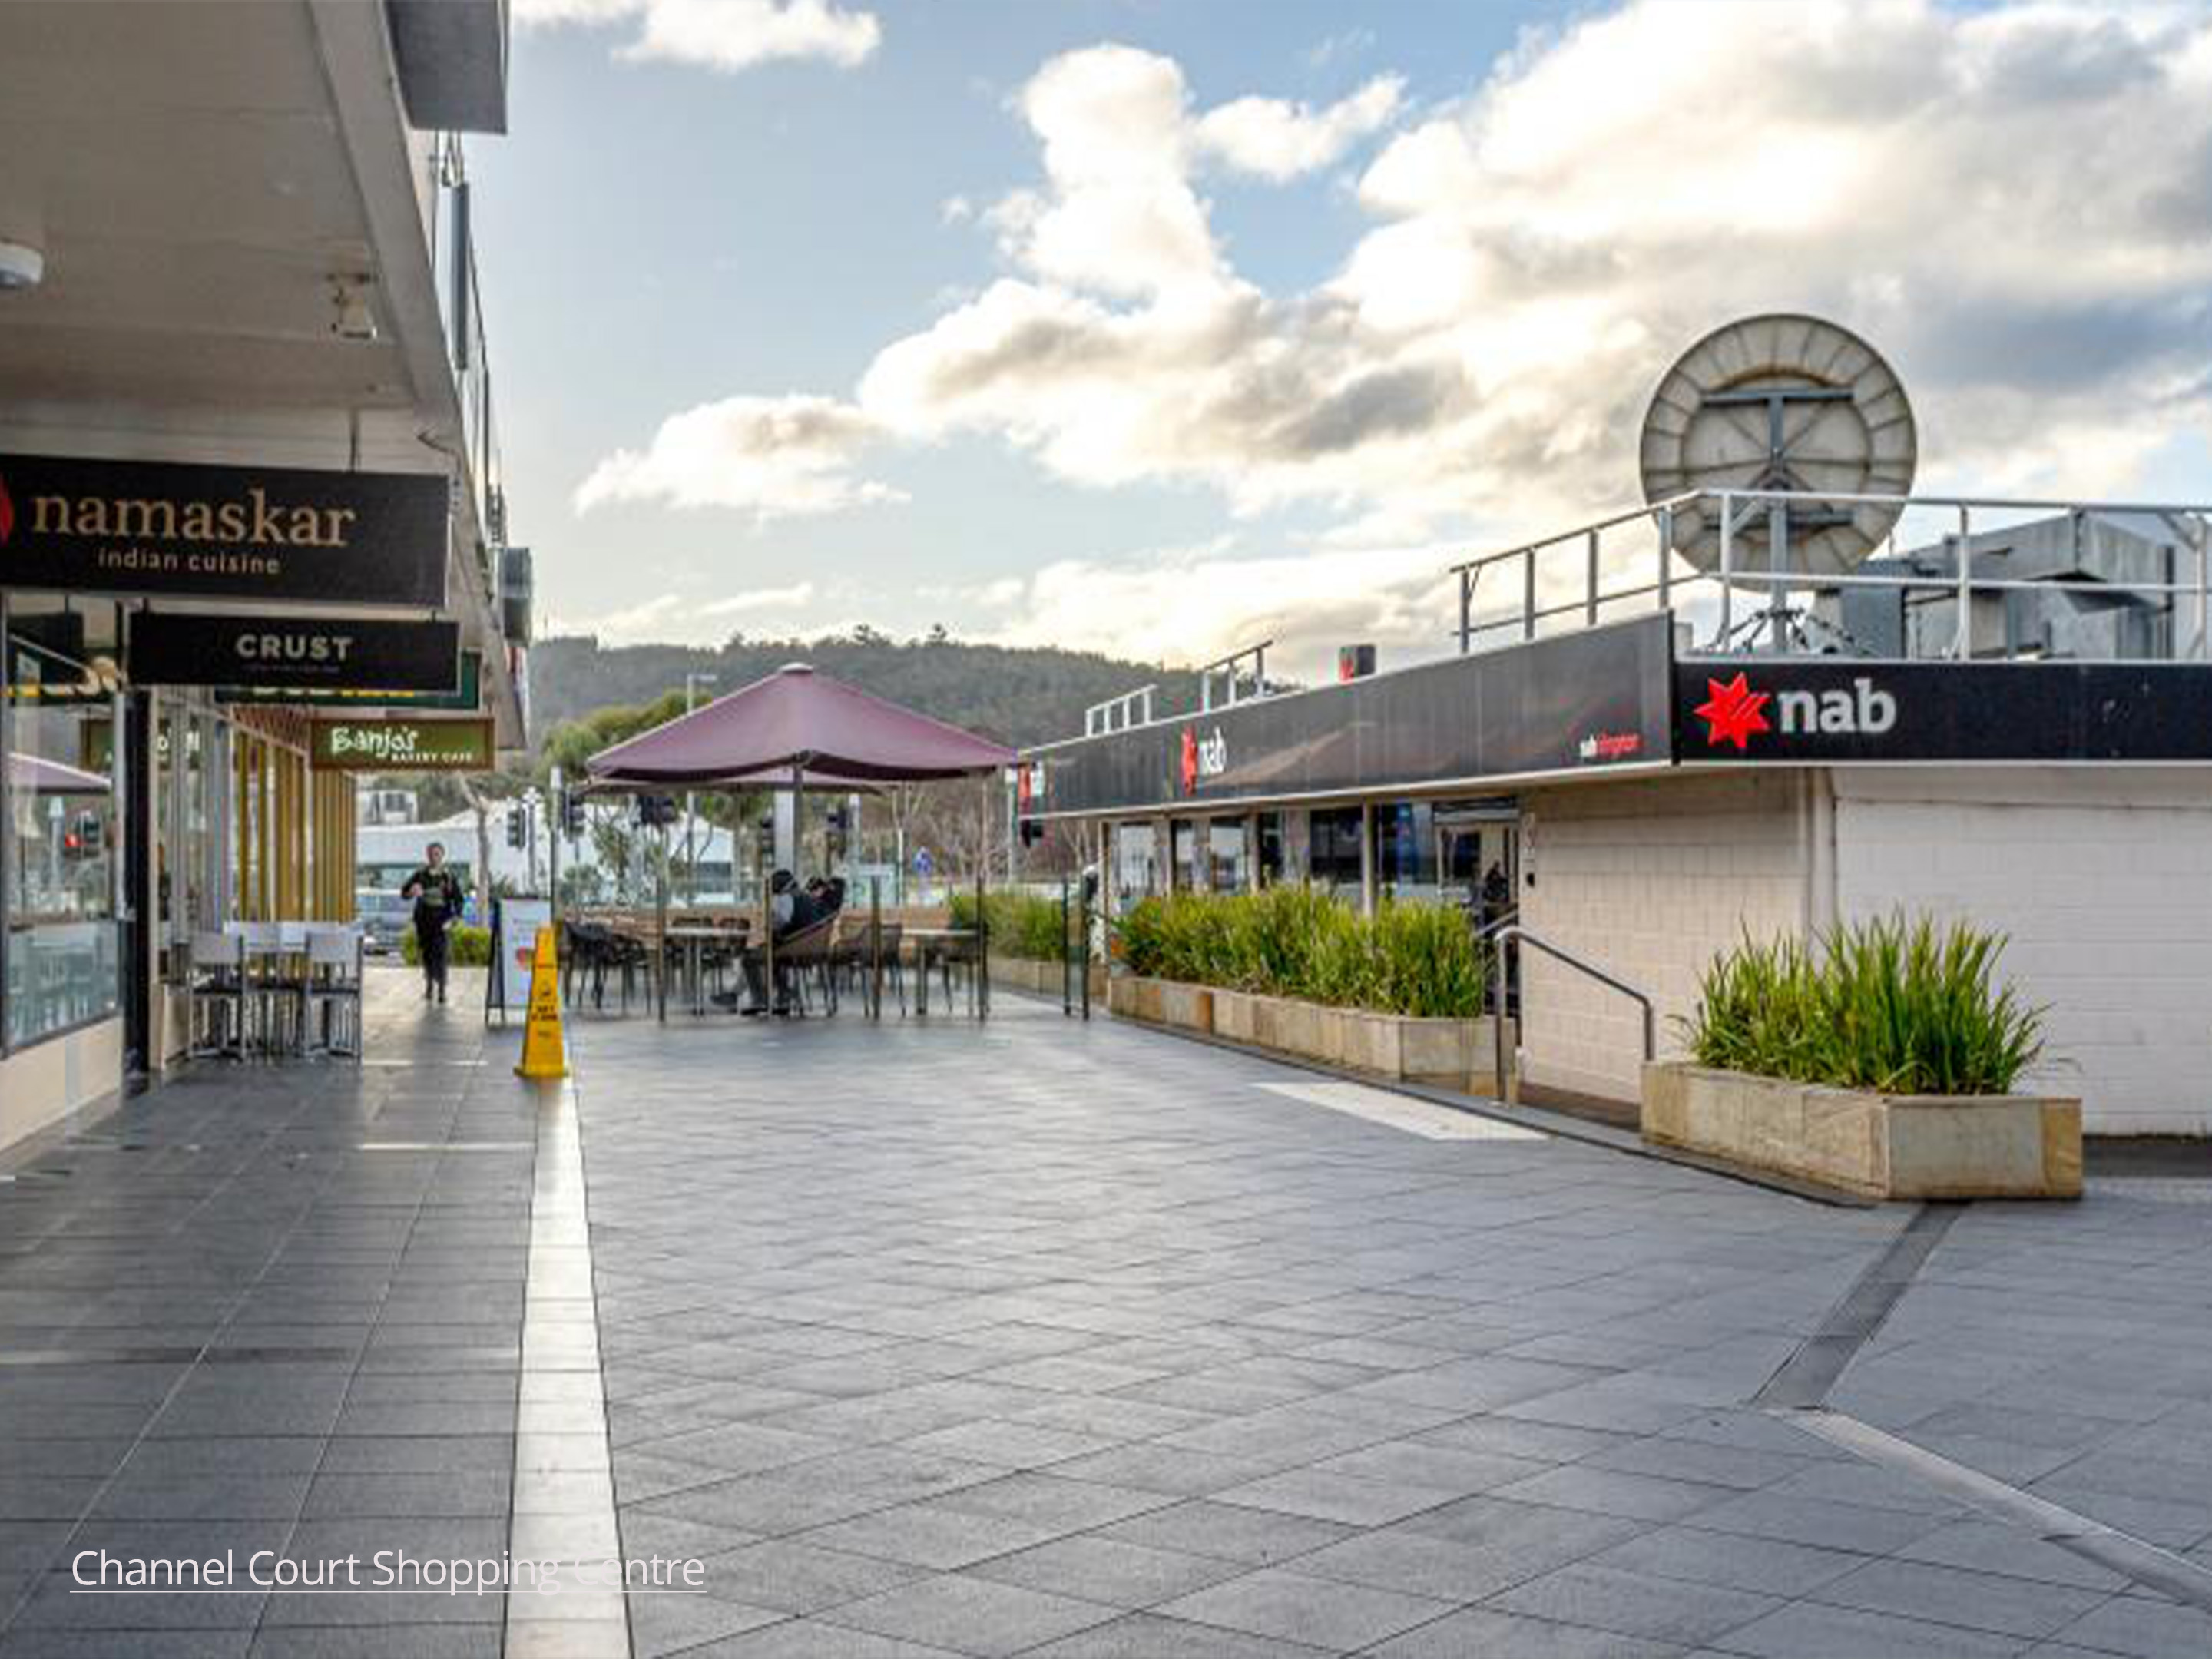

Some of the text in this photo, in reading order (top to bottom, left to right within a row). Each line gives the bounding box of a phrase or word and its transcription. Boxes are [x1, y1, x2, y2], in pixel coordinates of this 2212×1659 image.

[32, 488, 355, 548] namaskar
[98, 548, 281, 575] indian cuisine
[236, 634, 353, 661] CRUST
[1777, 677, 1896, 733] nab
[331, 725, 419, 758] Banjo's
[1198, 726, 1227, 776] nab
